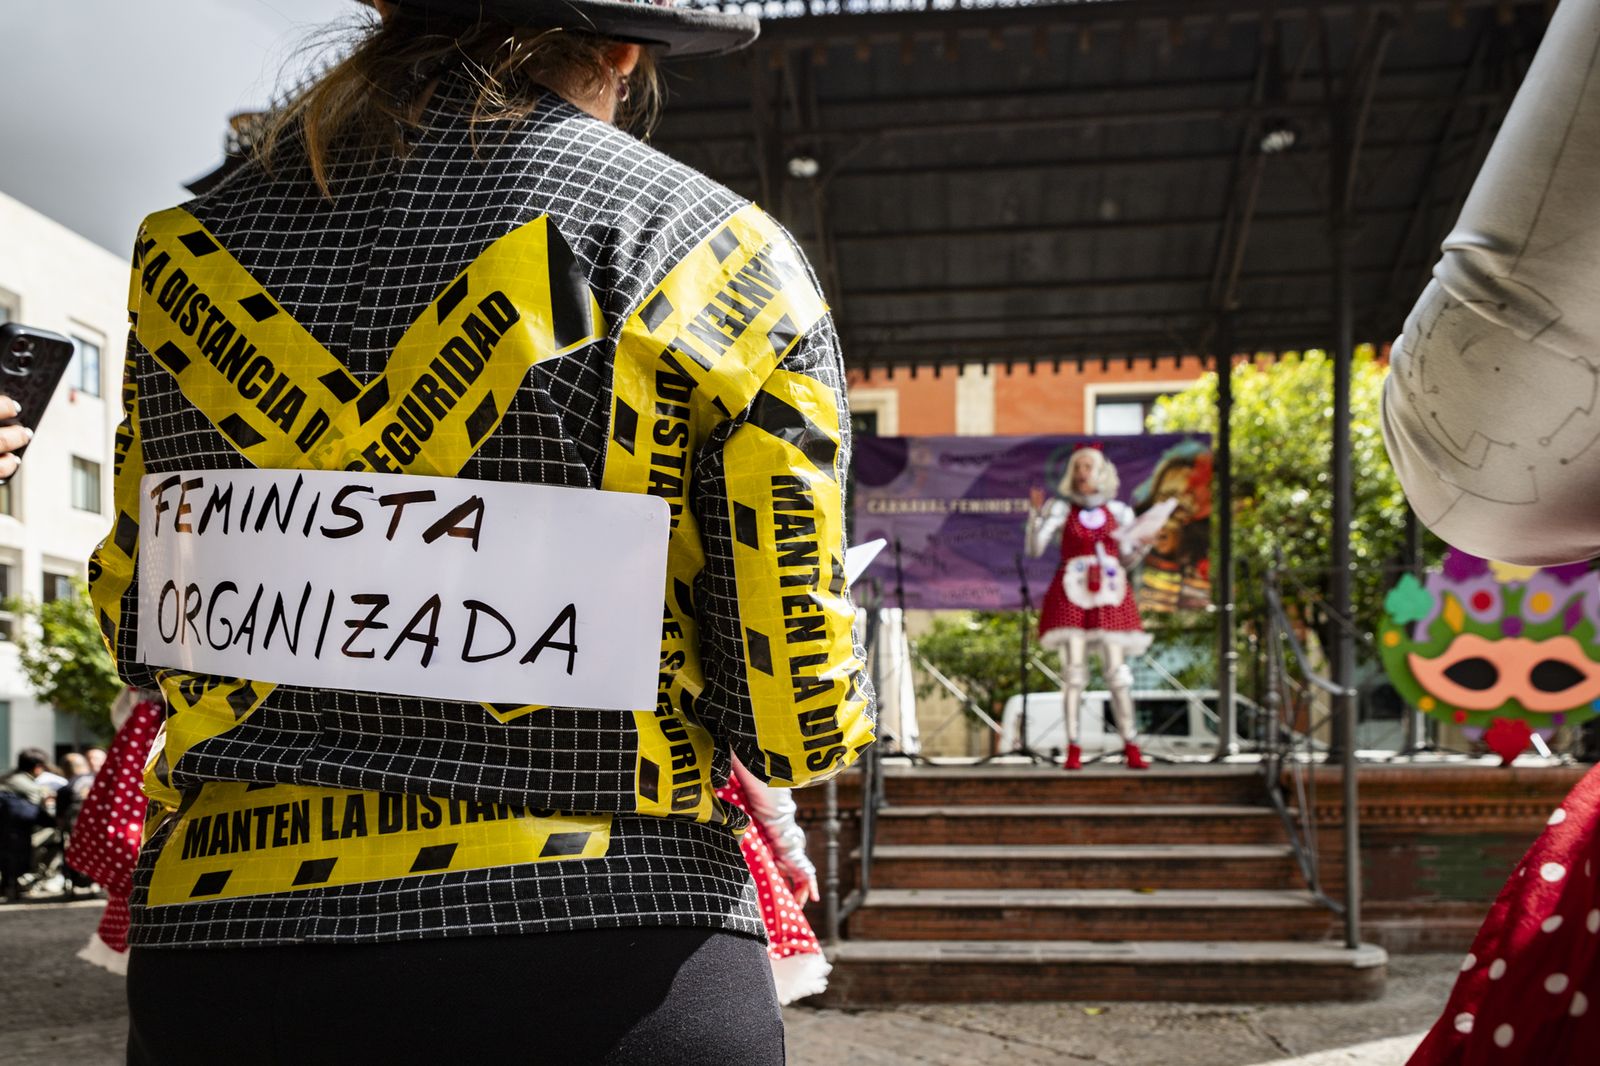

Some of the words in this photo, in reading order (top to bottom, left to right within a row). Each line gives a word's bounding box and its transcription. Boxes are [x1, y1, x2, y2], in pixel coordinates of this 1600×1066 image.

[686, 243, 783, 357] ANTEN
[157, 267, 307, 434] DISTANCIA
[295, 407, 332, 454] D
[647, 369, 691, 531] DISTA
[150, 474, 485, 552] FEMINISTA
[771, 475, 828, 644] MANTEN
[156, 579, 578, 676] ORGANIZADA
[789, 653, 835, 703] LA
[181, 798, 311, 861] MANTEN
[322, 794, 368, 841] LA
